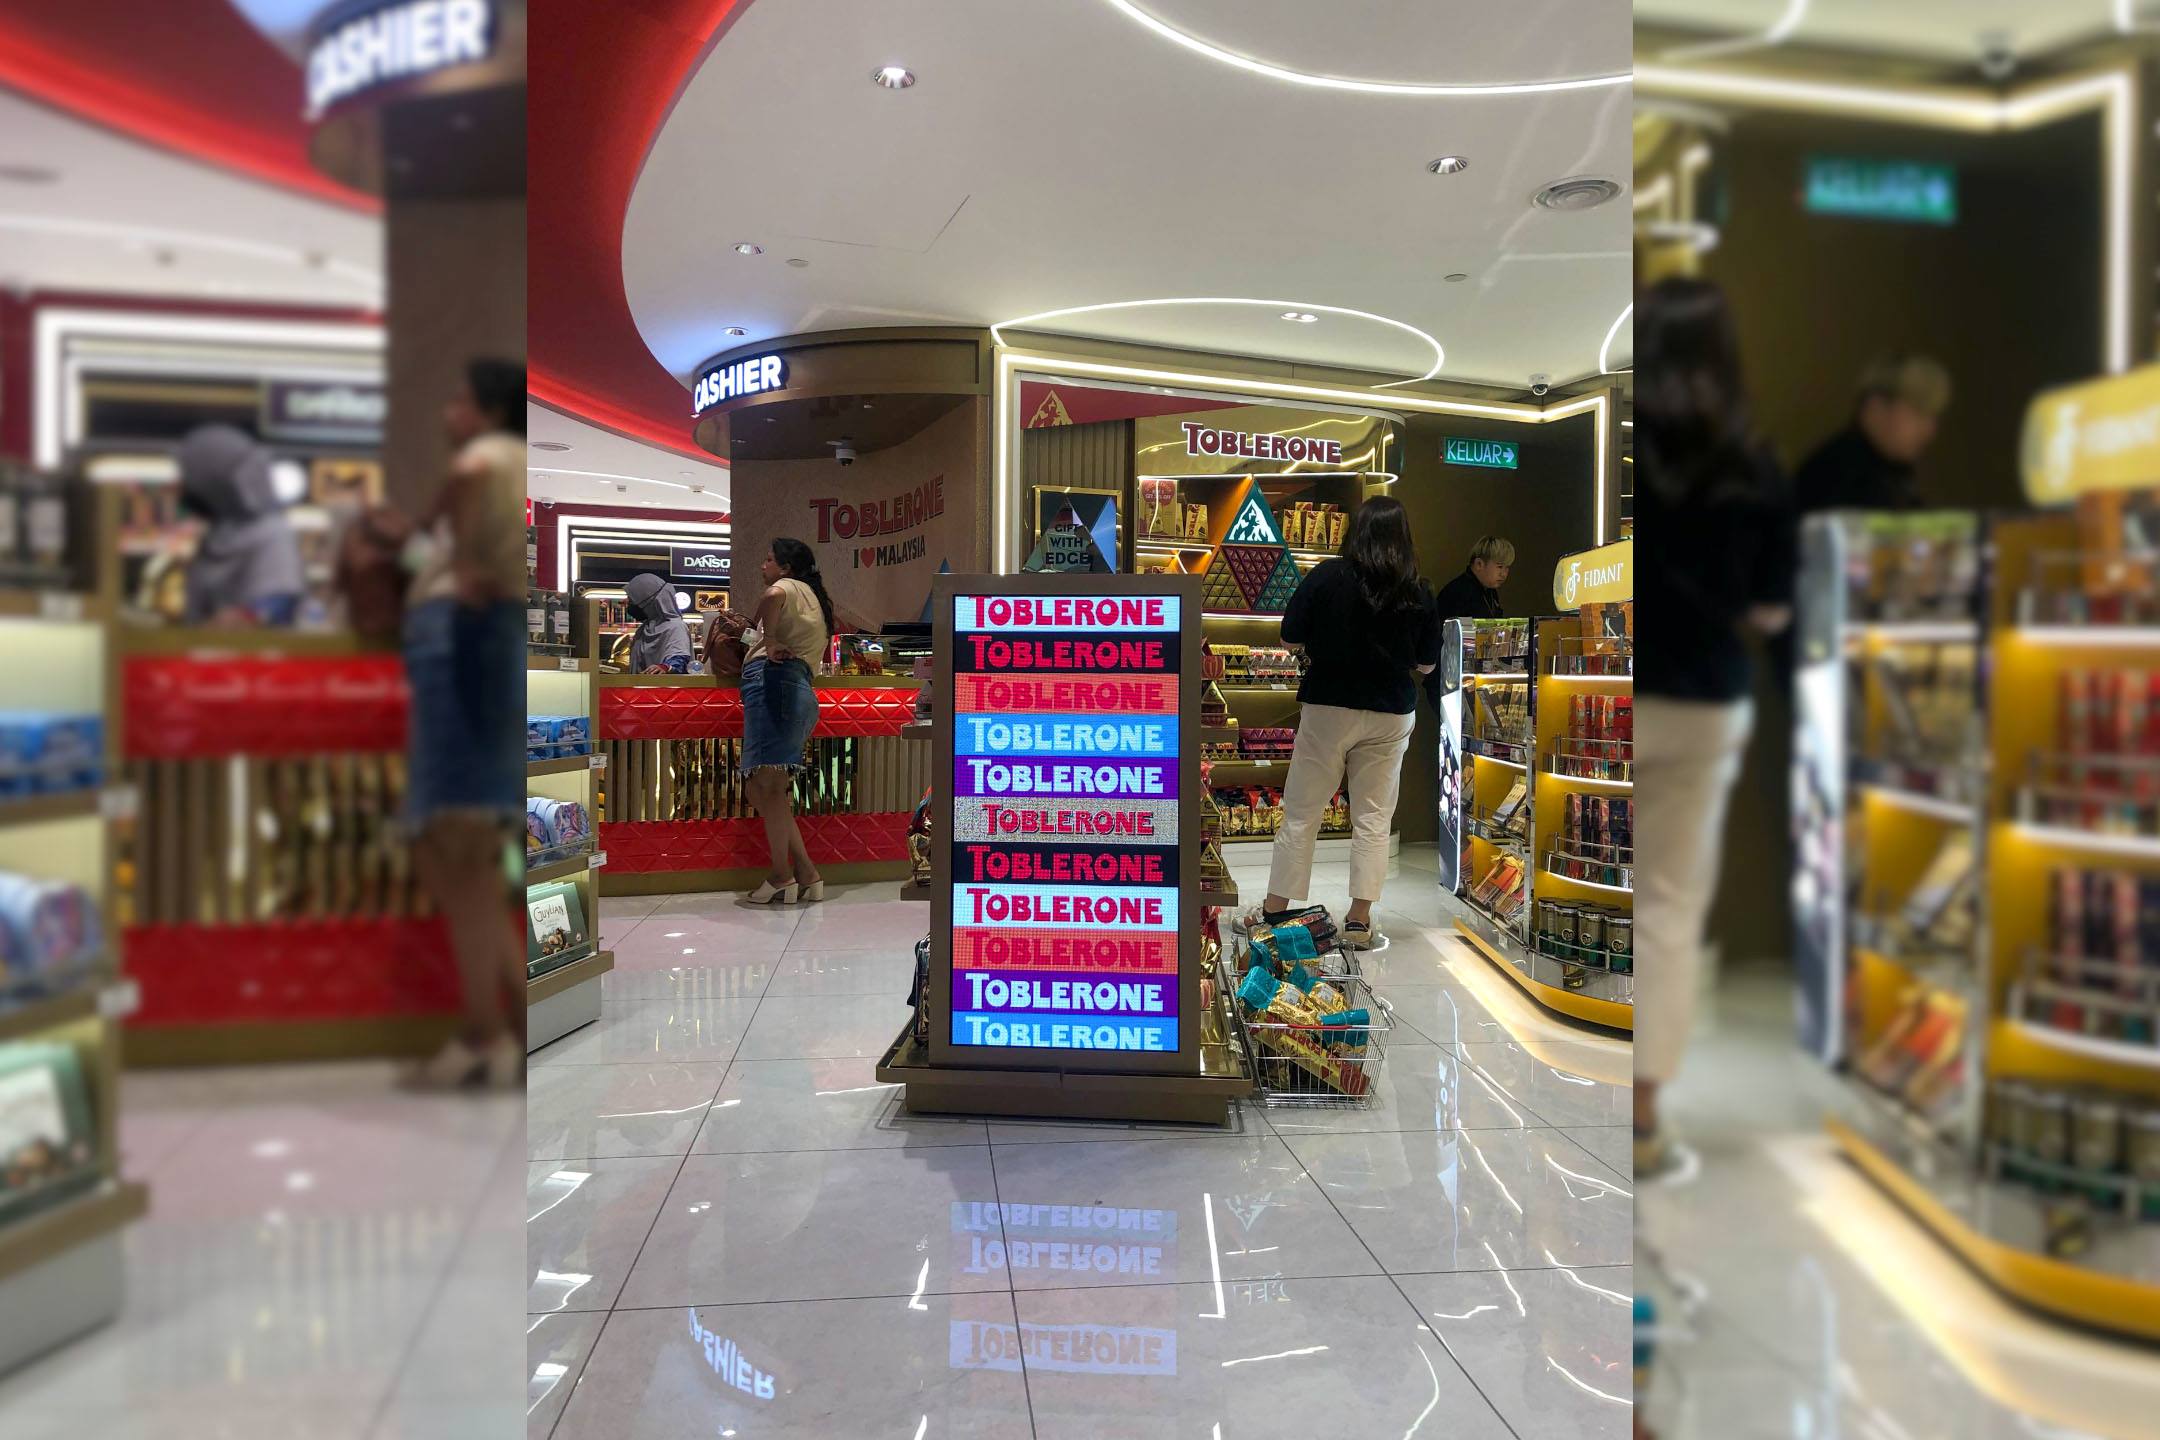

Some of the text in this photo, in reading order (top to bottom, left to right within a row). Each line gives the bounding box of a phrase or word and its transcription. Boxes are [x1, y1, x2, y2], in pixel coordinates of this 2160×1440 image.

[694, 355, 782, 413] CASHIER
[1182, 422, 1342, 465] TOBLERONE
[1447, 440, 1502, 464] KELUAR
[809, 473, 945, 543] TOBLERONE
[1050, 537, 1083, 548] WITH
[1055, 524, 1079, 533] GIFT
[876, 535, 926, 567] MALAYSIA
[1045, 552, 1089, 565] EDGE
[968, 595, 1164, 628] TOBLERONE
[967, 635, 1164, 670] TOBLERONE
[967, 676, 1164, 711] TOBLERONE
[967, 718, 1163, 753] TOBLERONE
[967, 759, 1164, 794] TOBLERONE
[982, 803, 1154, 835] TOBLERONE
[966, 845, 1163, 882] TOBLERONE
[966, 888, 1163, 925] TOBLERONE
[965, 931, 1163, 968] TOBLERONE
[965, 973, 1163, 1012] TOBLERONE
[965, 1016, 1163, 1050] TOBLERONE
